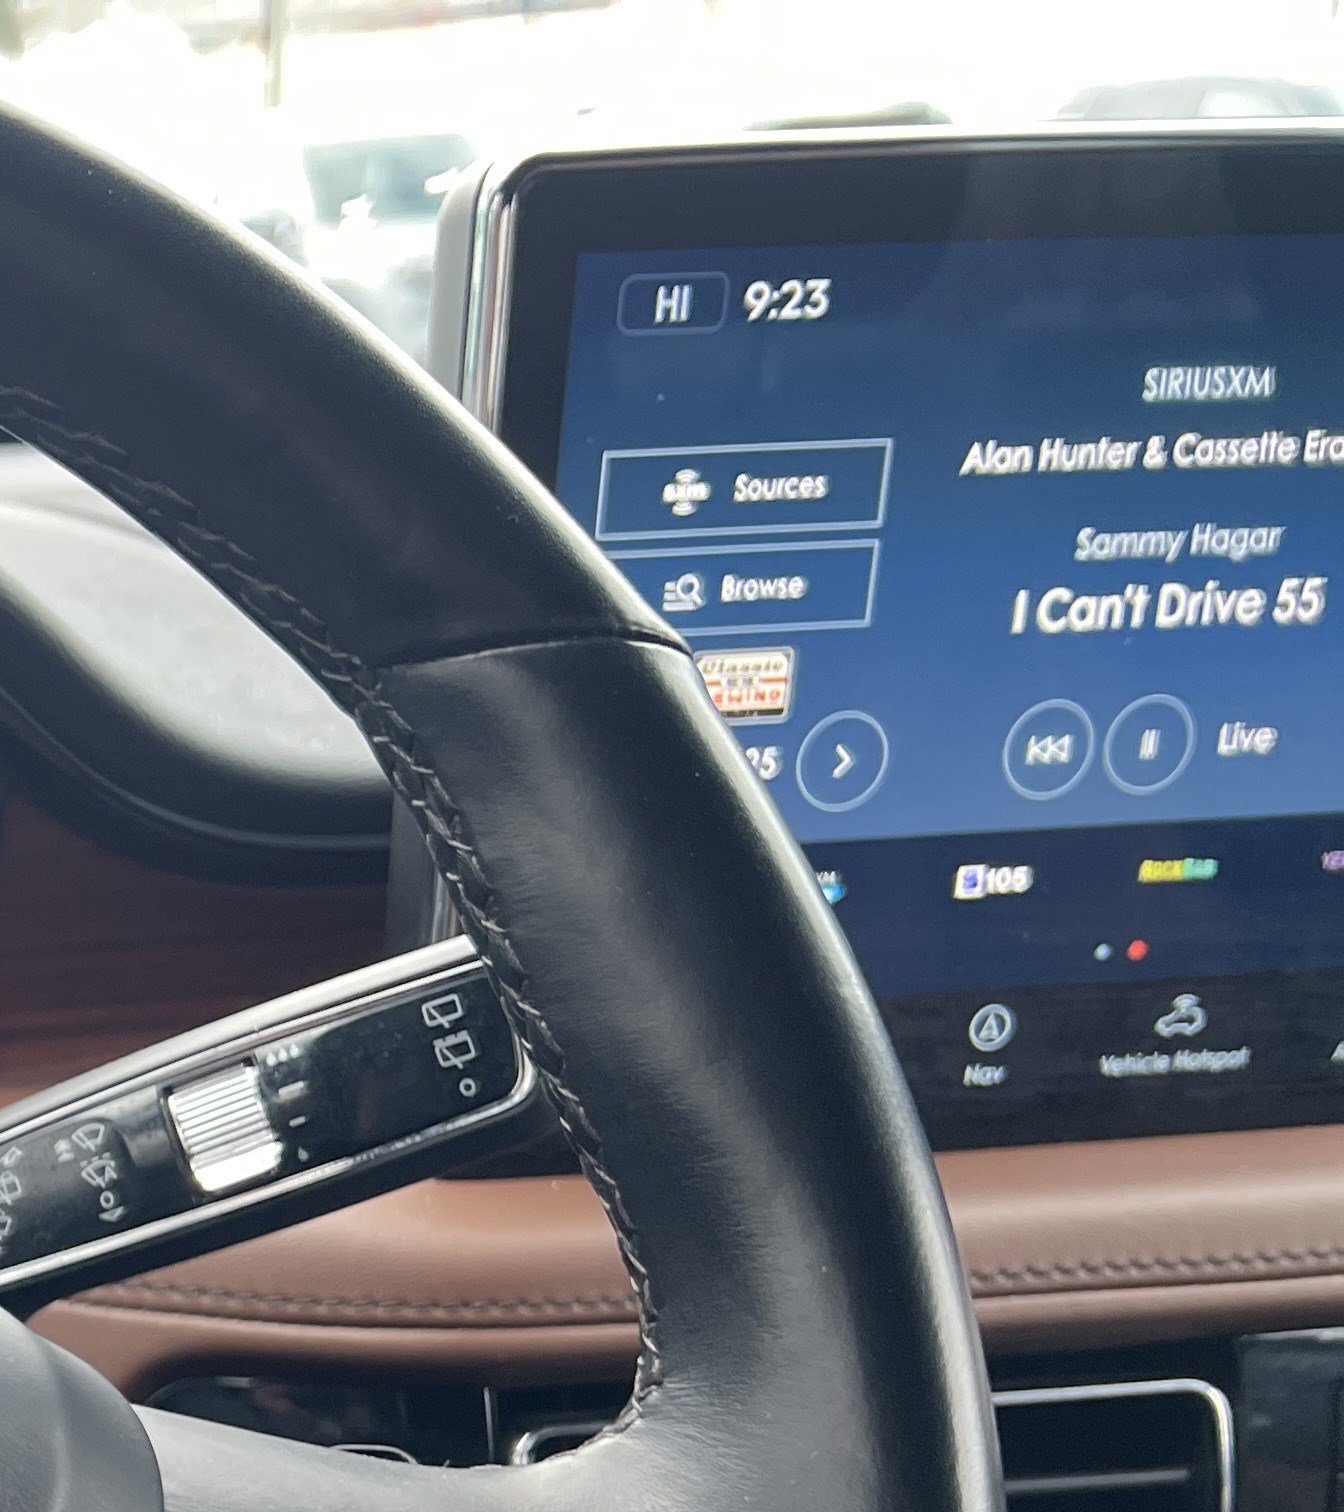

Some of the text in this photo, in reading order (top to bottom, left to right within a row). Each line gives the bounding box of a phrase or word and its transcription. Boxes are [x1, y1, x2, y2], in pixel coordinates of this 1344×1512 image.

[654, 284, 693, 324] HI
[743, 276, 832, 323] 9:23
[1142, 366, 1277, 402] SIRIUSXM
[958, 438, 1034, 477] Alan
[1037, 436, 1142, 474] Hunter
[1143, 434, 1168, 471] &
[1173, 430, 1300, 469] Cassette
[732, 472, 831, 502] Sources
[1073, 522, 1287, 563] Sammy Hagar
[719, 573, 810, 603] Browse
[1010, 576, 1328, 635] I Can't Drive 55
[1216, 720, 1281, 758] Live
[985, 864, 1034, 895] 105
[963, 1063, 1008, 1088] Nav
